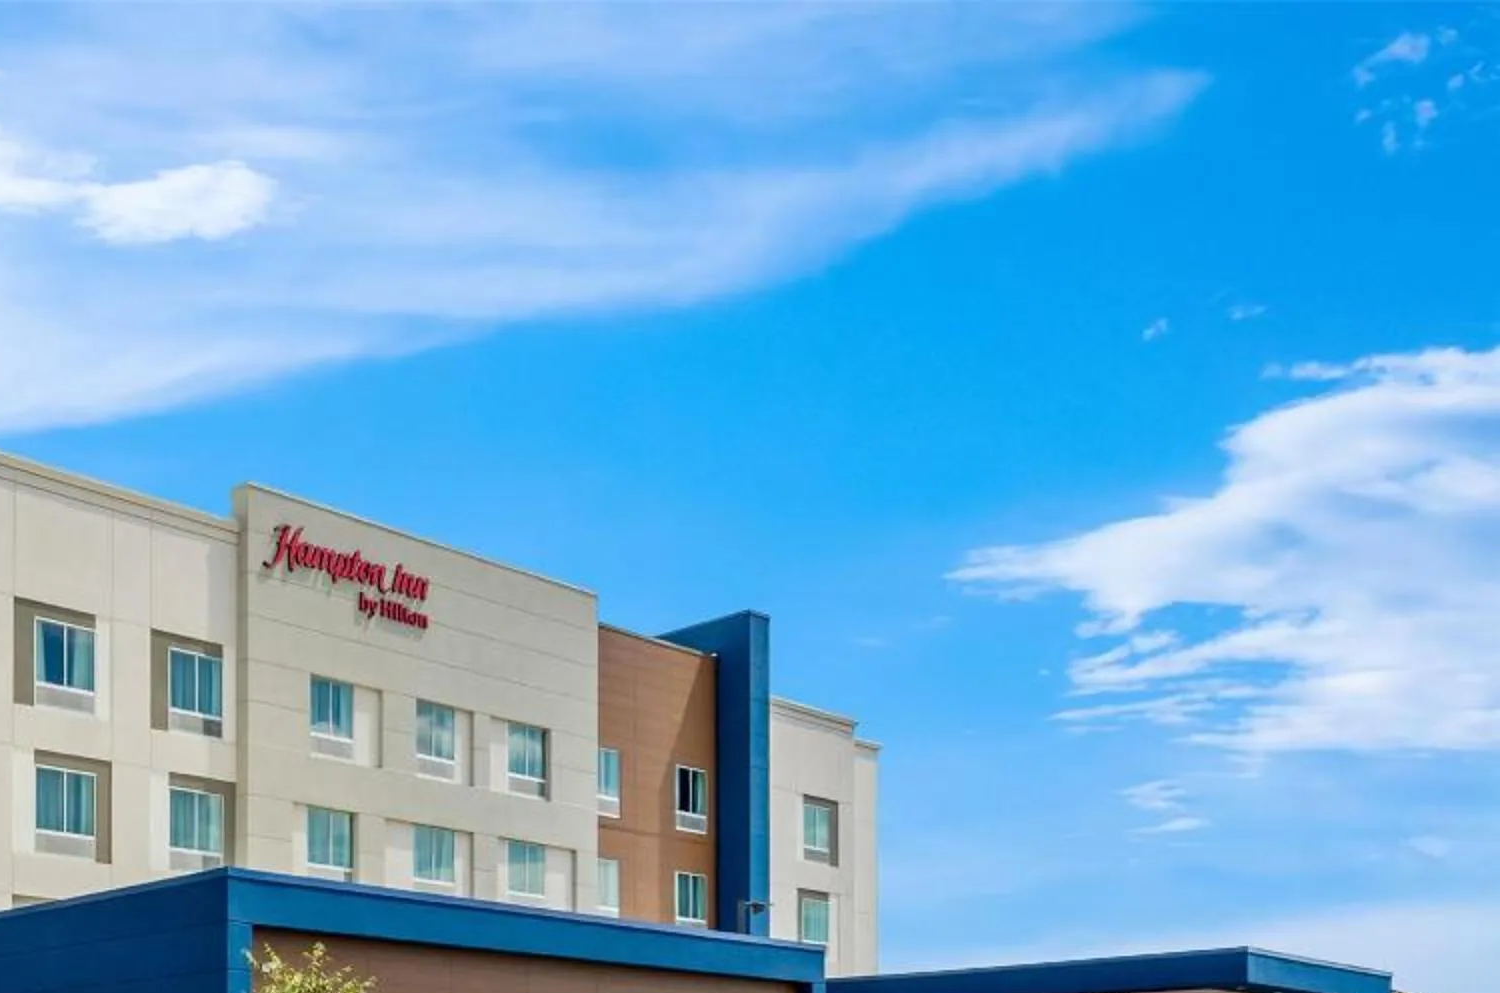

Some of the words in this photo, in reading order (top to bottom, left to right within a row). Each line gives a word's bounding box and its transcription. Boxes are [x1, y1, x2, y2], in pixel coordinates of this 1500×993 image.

[263, 525, 388, 594] Hampton
[392, 563, 430, 602] Inn
[358, 591, 378, 619] by
[380, 598, 428, 630] Hilton
